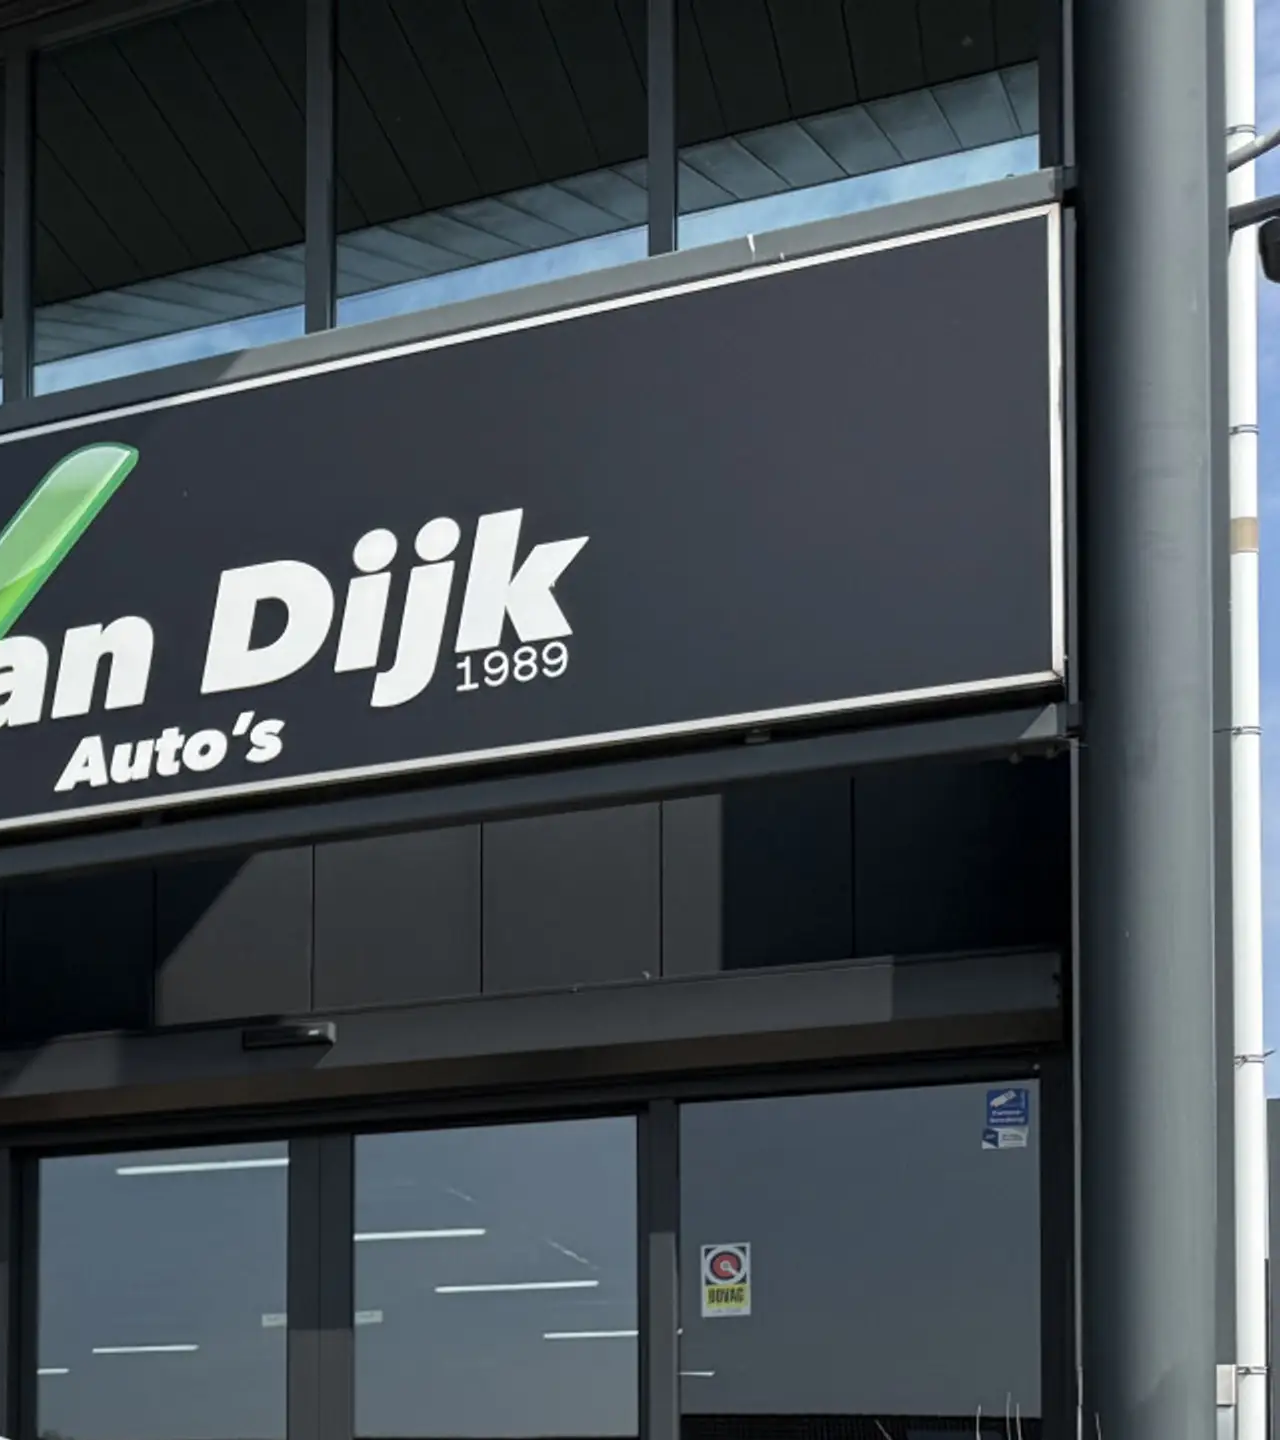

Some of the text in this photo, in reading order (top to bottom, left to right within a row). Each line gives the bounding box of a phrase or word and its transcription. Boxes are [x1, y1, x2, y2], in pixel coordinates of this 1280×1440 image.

[200, 508, 589, 707] Dijk
[456, 641, 569, 692] 1989
[54, 711, 284, 792] Auto's
